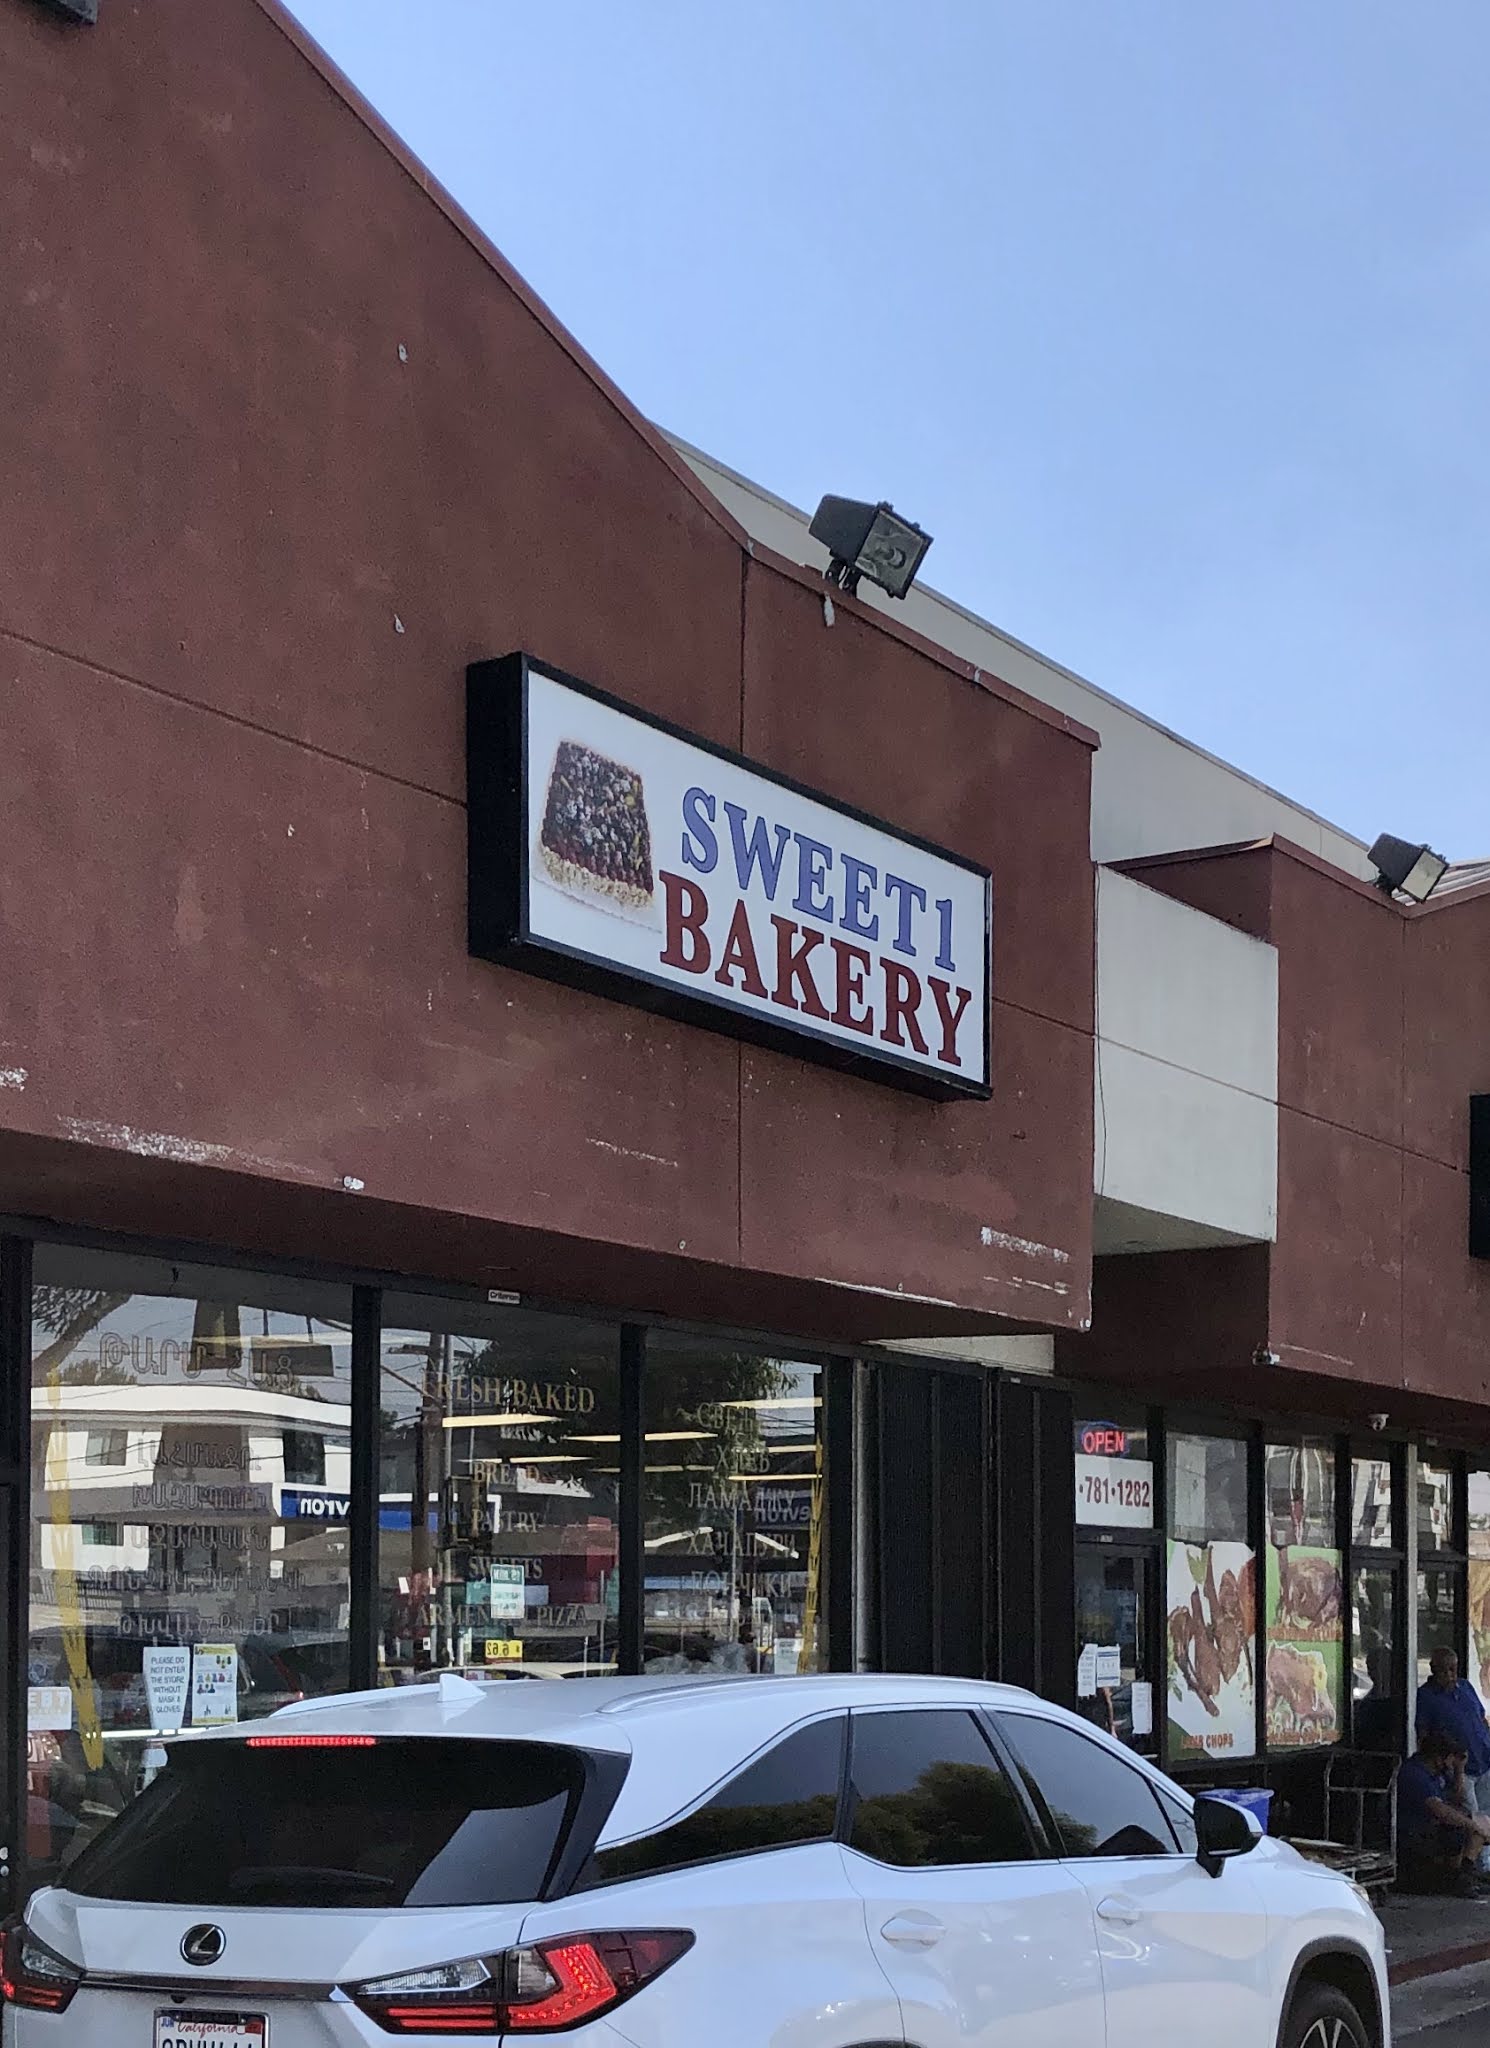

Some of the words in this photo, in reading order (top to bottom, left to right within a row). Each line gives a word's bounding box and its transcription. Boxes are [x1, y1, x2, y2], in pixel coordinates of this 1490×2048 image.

[682, 787, 955, 972] SWEET1
[659, 870, 972, 1066] BAKERY
[422, 1371, 502, 1405] FRESH
[513, 1379, 595, 1413] BAKED
[1083, 1431, 1125, 1453] OPEN
[416, 1604, 529, 1627] ARMEN
[537, 1604, 587, 1627] PIZZA
[151, 1656, 174, 1665] PLEASE
[175, 1656, 185, 1664] DO
[151, 1666, 163, 1674] NOT
[164, 1666, 185, 1674] ENTER
[151, 1676, 162, 1684] THE
[153, 1685, 181, 1693] WITHOUT
[156, 1705, 181, 1713] GLOVES
[1206, 1733, 1234, 1749] CHOPS
[178, 2021, 239, 2039] California
